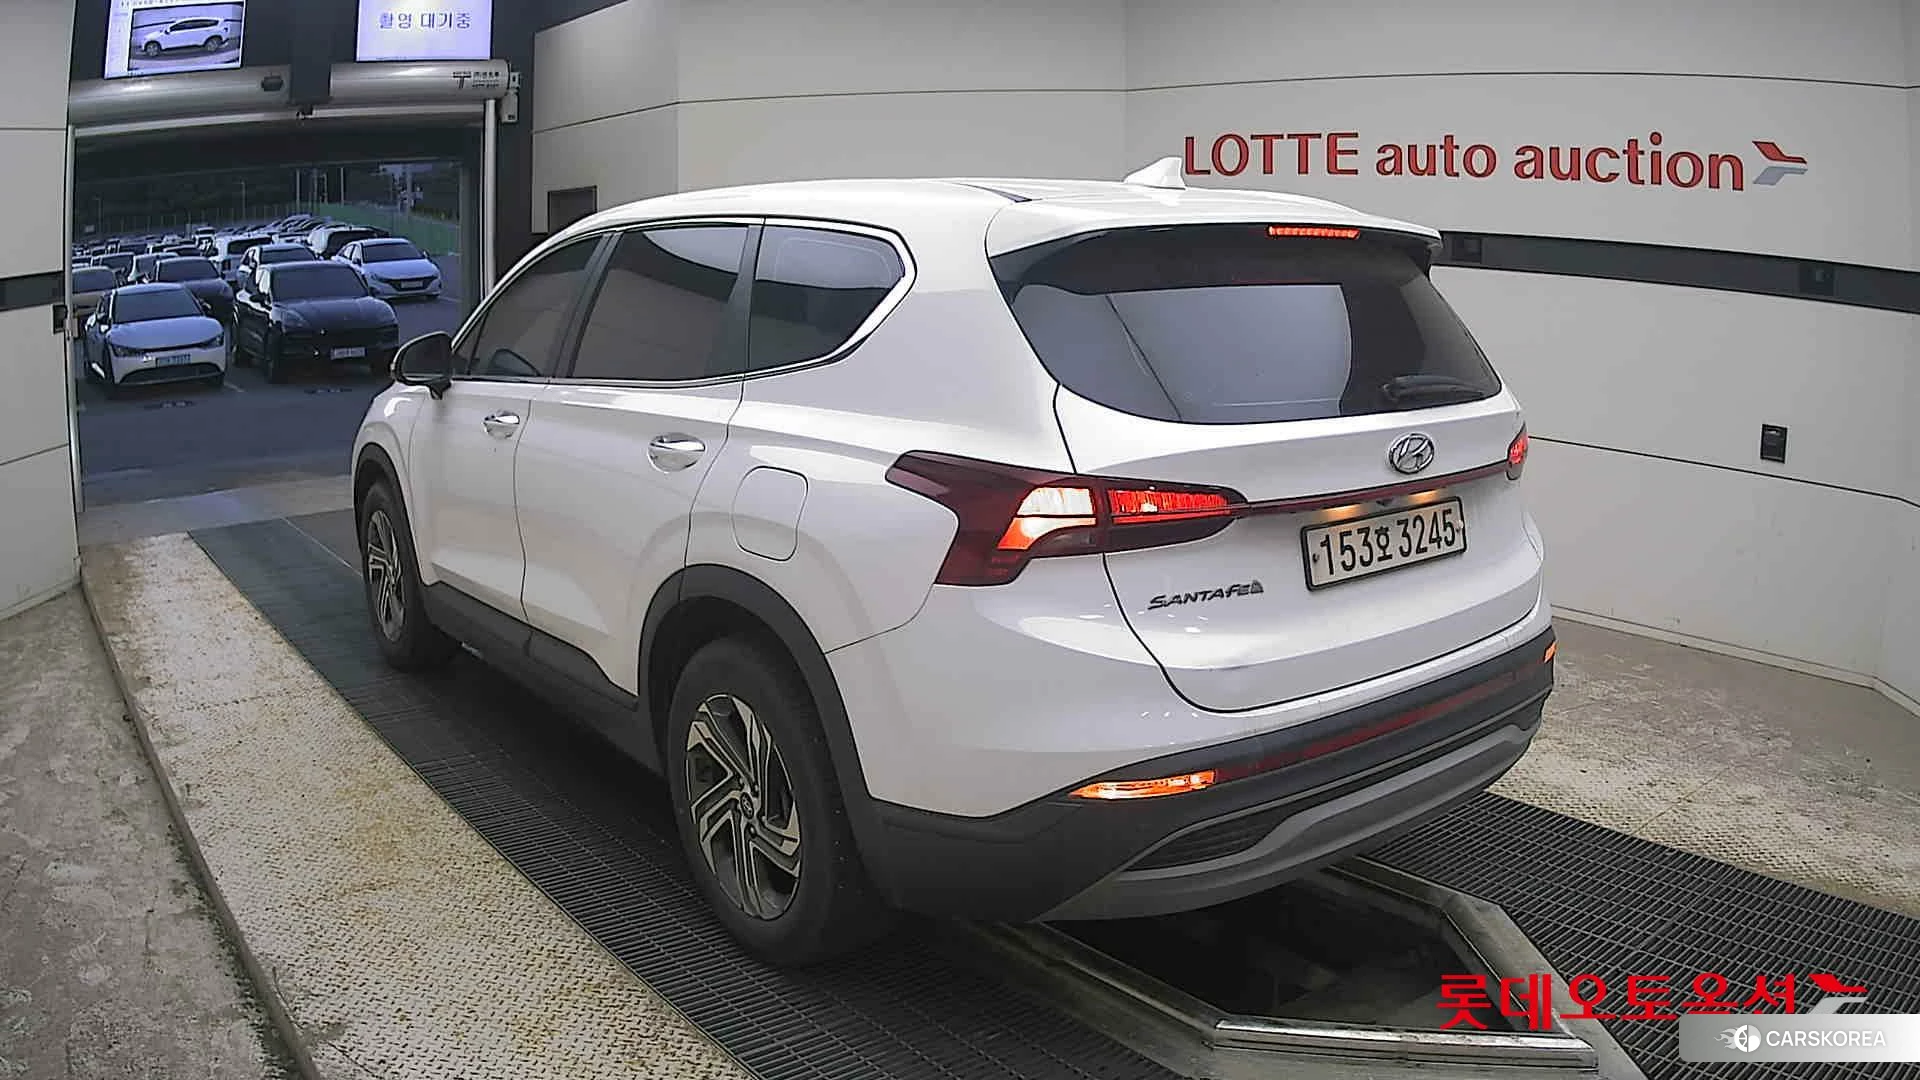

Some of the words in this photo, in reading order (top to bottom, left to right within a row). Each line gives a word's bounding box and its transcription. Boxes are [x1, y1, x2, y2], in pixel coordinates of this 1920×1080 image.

[420, 12, 471, 29] 대기중
[1185, 132, 1359, 176] LOTTE
[1376, 134, 1498, 178] auto
[1513, 131, 1744, 191] auction
